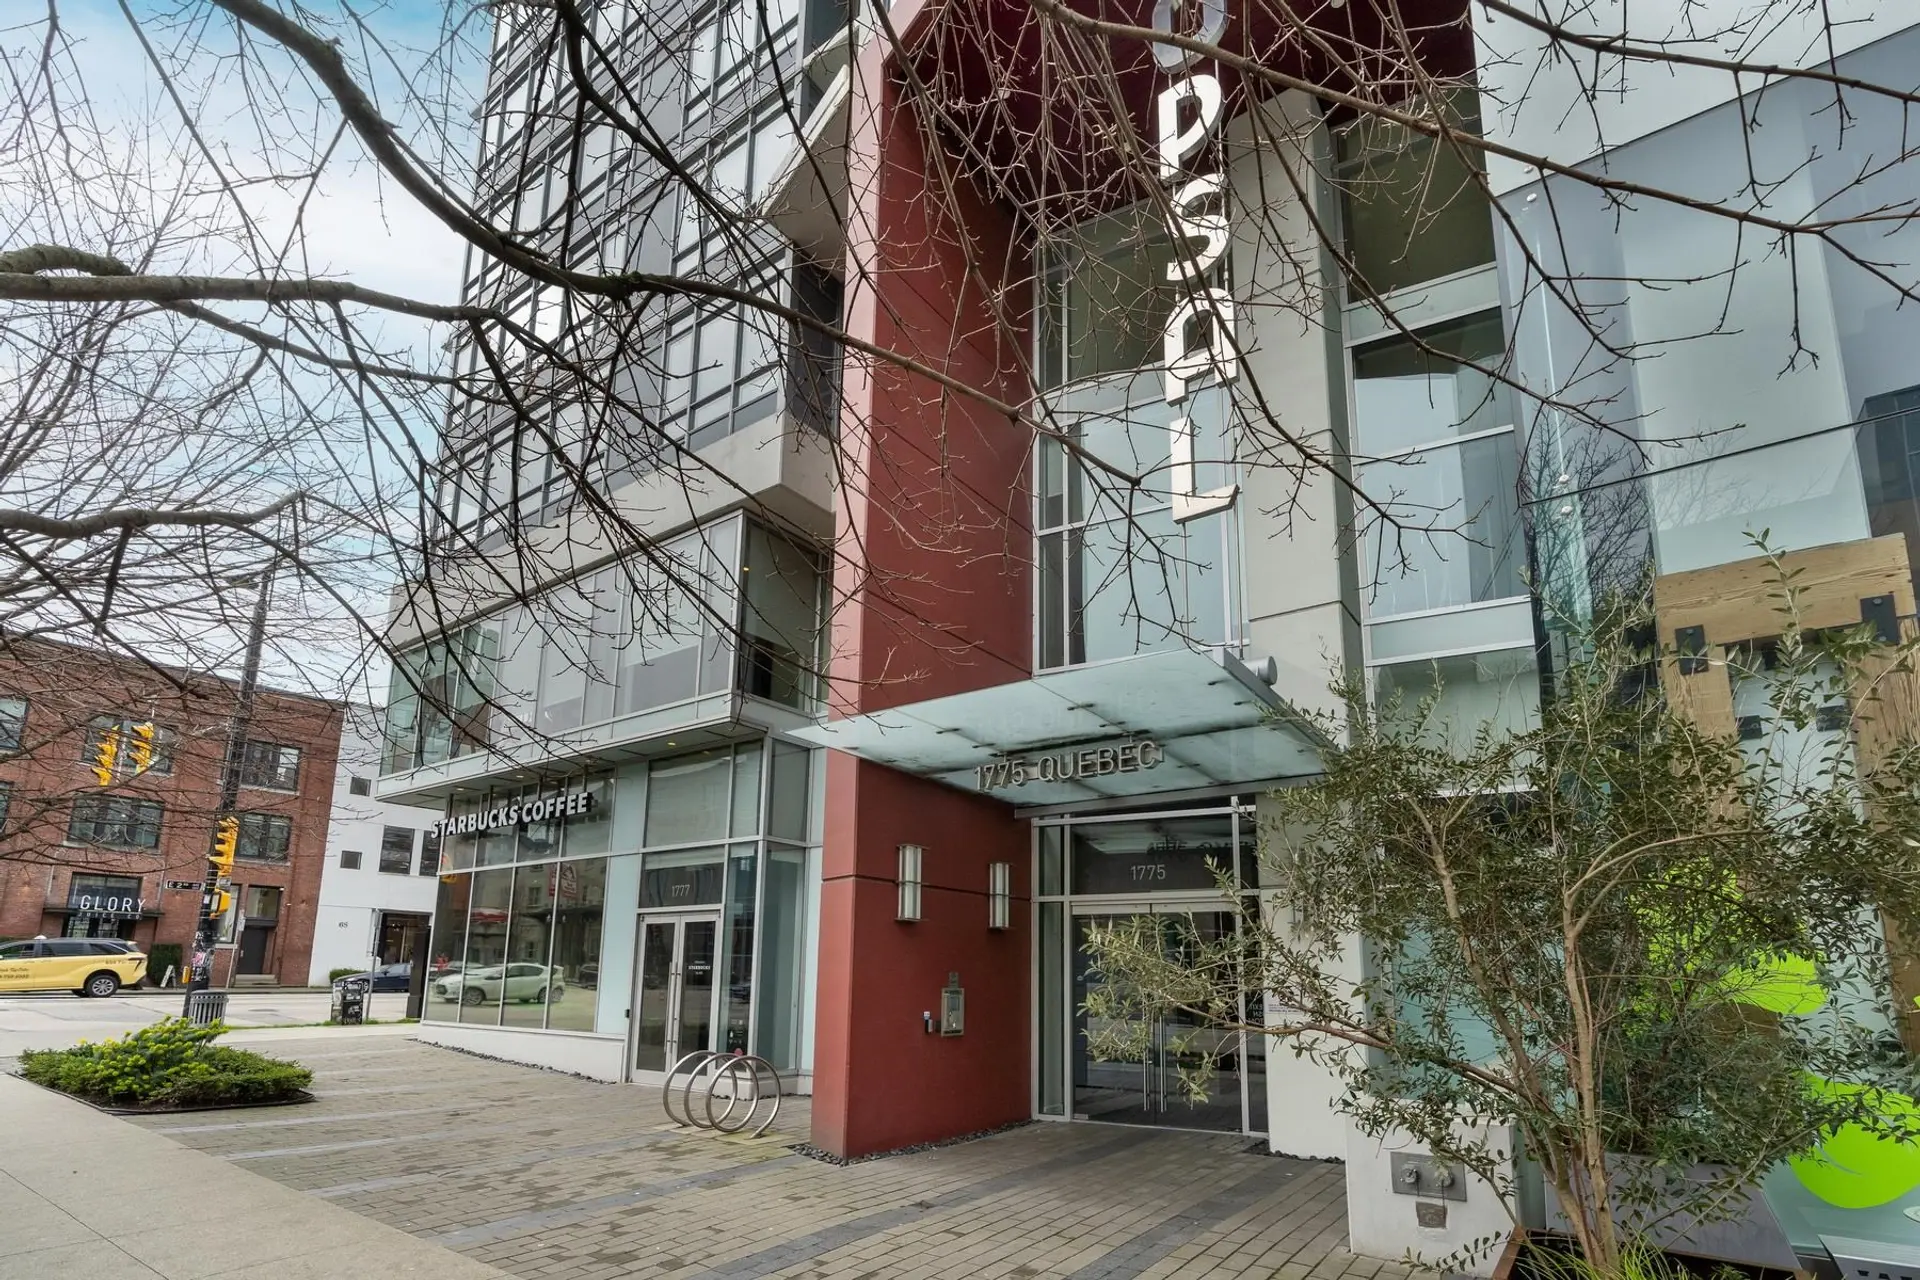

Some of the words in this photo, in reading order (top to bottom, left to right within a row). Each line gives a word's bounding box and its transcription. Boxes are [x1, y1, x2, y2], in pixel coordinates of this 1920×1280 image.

[974, 760, 1025, 791] 1775
[1036, 740, 1158, 781] QUEBEC
[431, 804, 519, 839] STARBUCKS
[521, 792, 589, 823] COFFEE
[1130, 864, 1166, 880] 1775
[671, 884, 691, 898] 1777
[80, 894, 146, 912] GLORY
